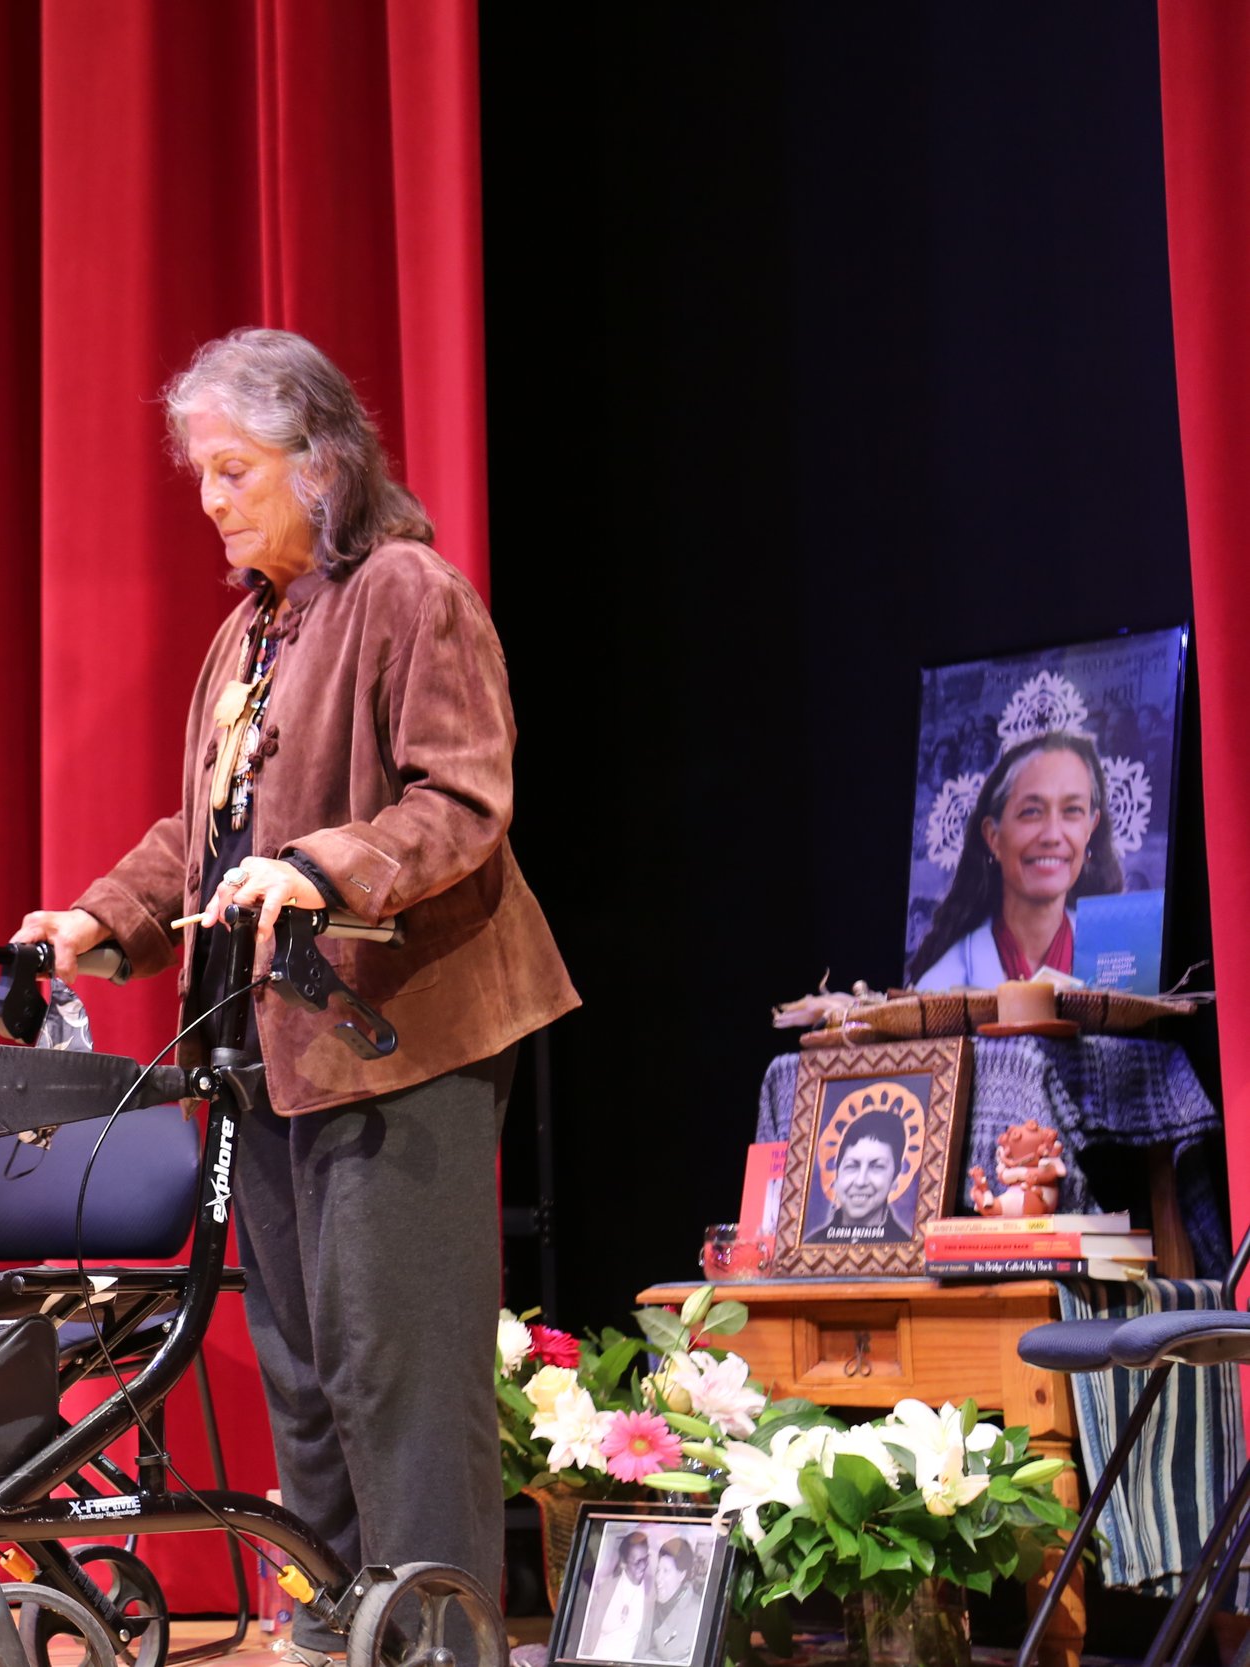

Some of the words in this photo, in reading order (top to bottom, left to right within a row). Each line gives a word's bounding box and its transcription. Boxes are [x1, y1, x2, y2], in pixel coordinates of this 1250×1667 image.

[206, 1116, 235, 1224] explore
[827, 1226, 851, 1239] GLORIA
[1005, 1260, 1024, 1272] Called
[1025, 1260, 1036, 1273] My
